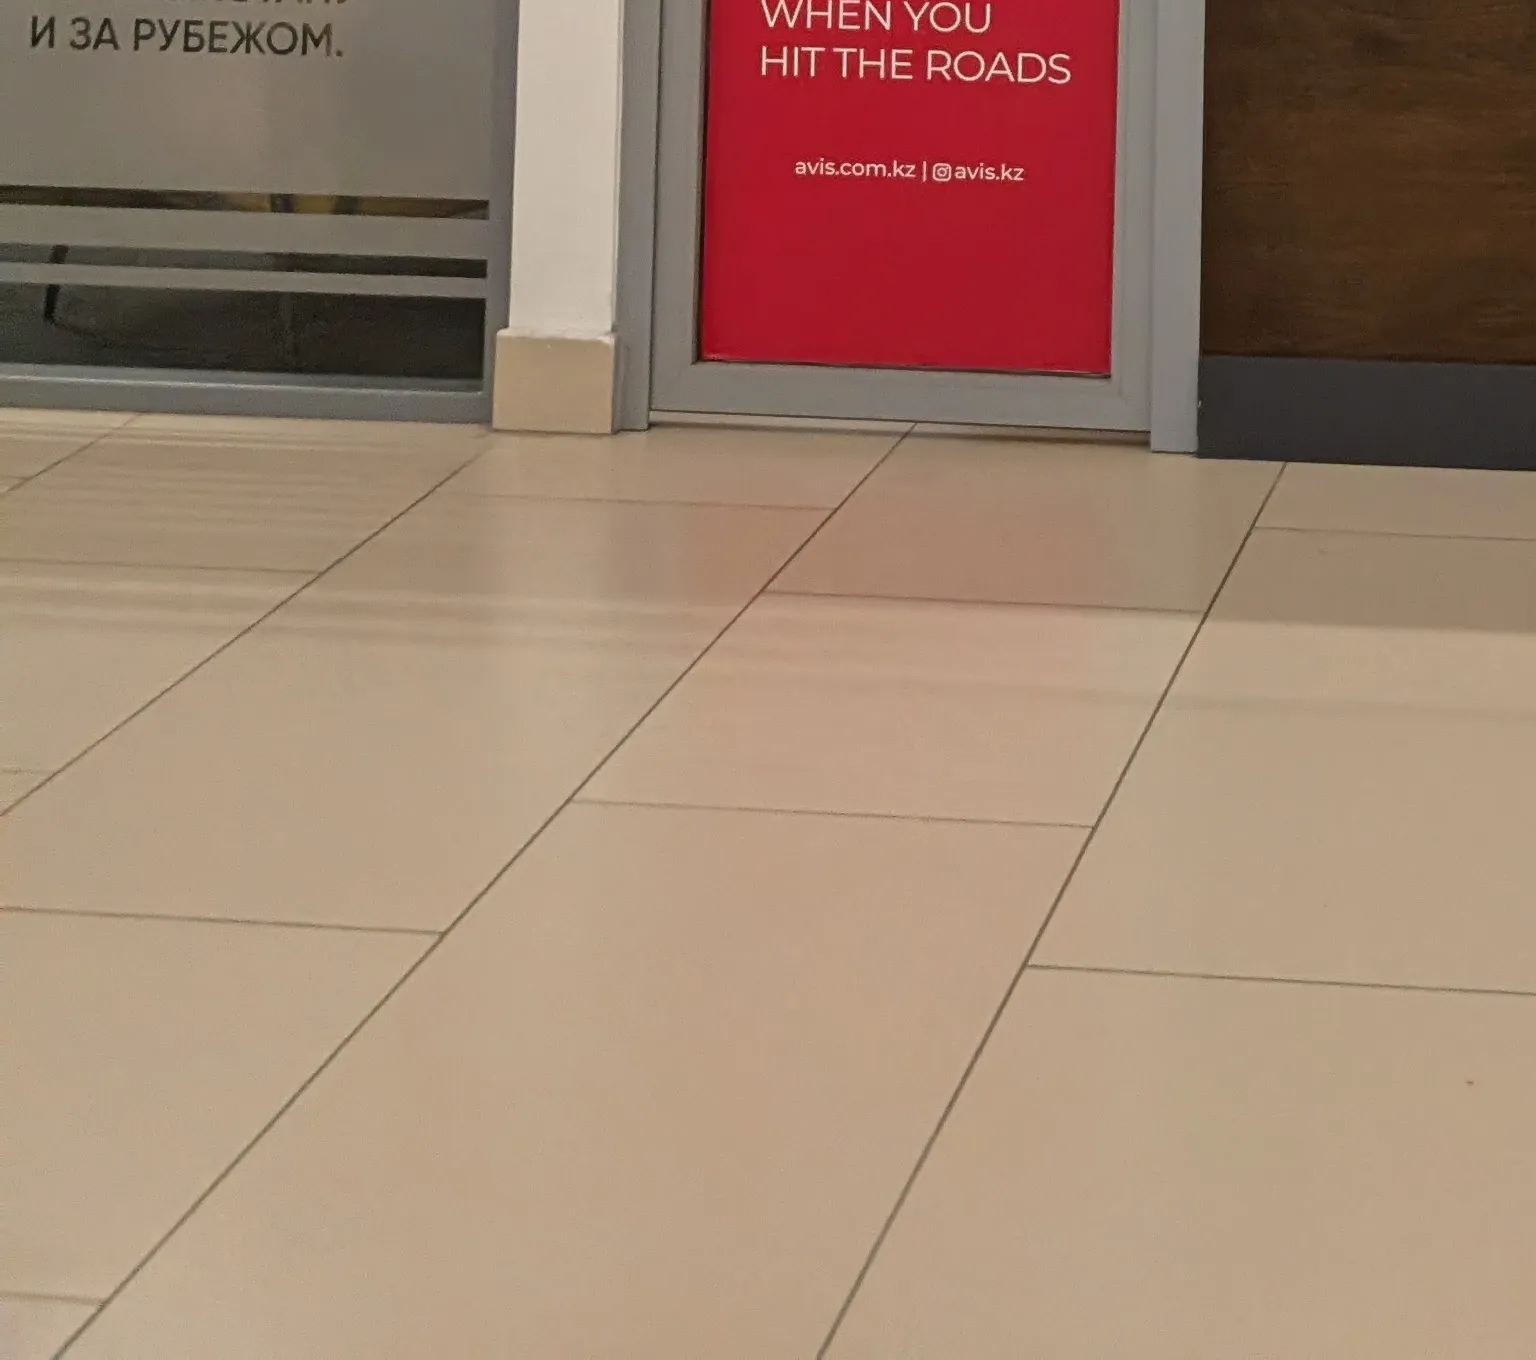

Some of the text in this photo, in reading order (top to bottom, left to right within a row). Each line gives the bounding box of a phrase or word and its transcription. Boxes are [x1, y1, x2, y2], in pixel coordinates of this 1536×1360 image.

[903, 0, 991, 34] YOU
[30, 15, 345, 58] И ЗА РУБЕЖОМ.
[761, 46, 1072, 85] HIT THE ROADS
[794, 157, 917, 178] avis.com.kz
